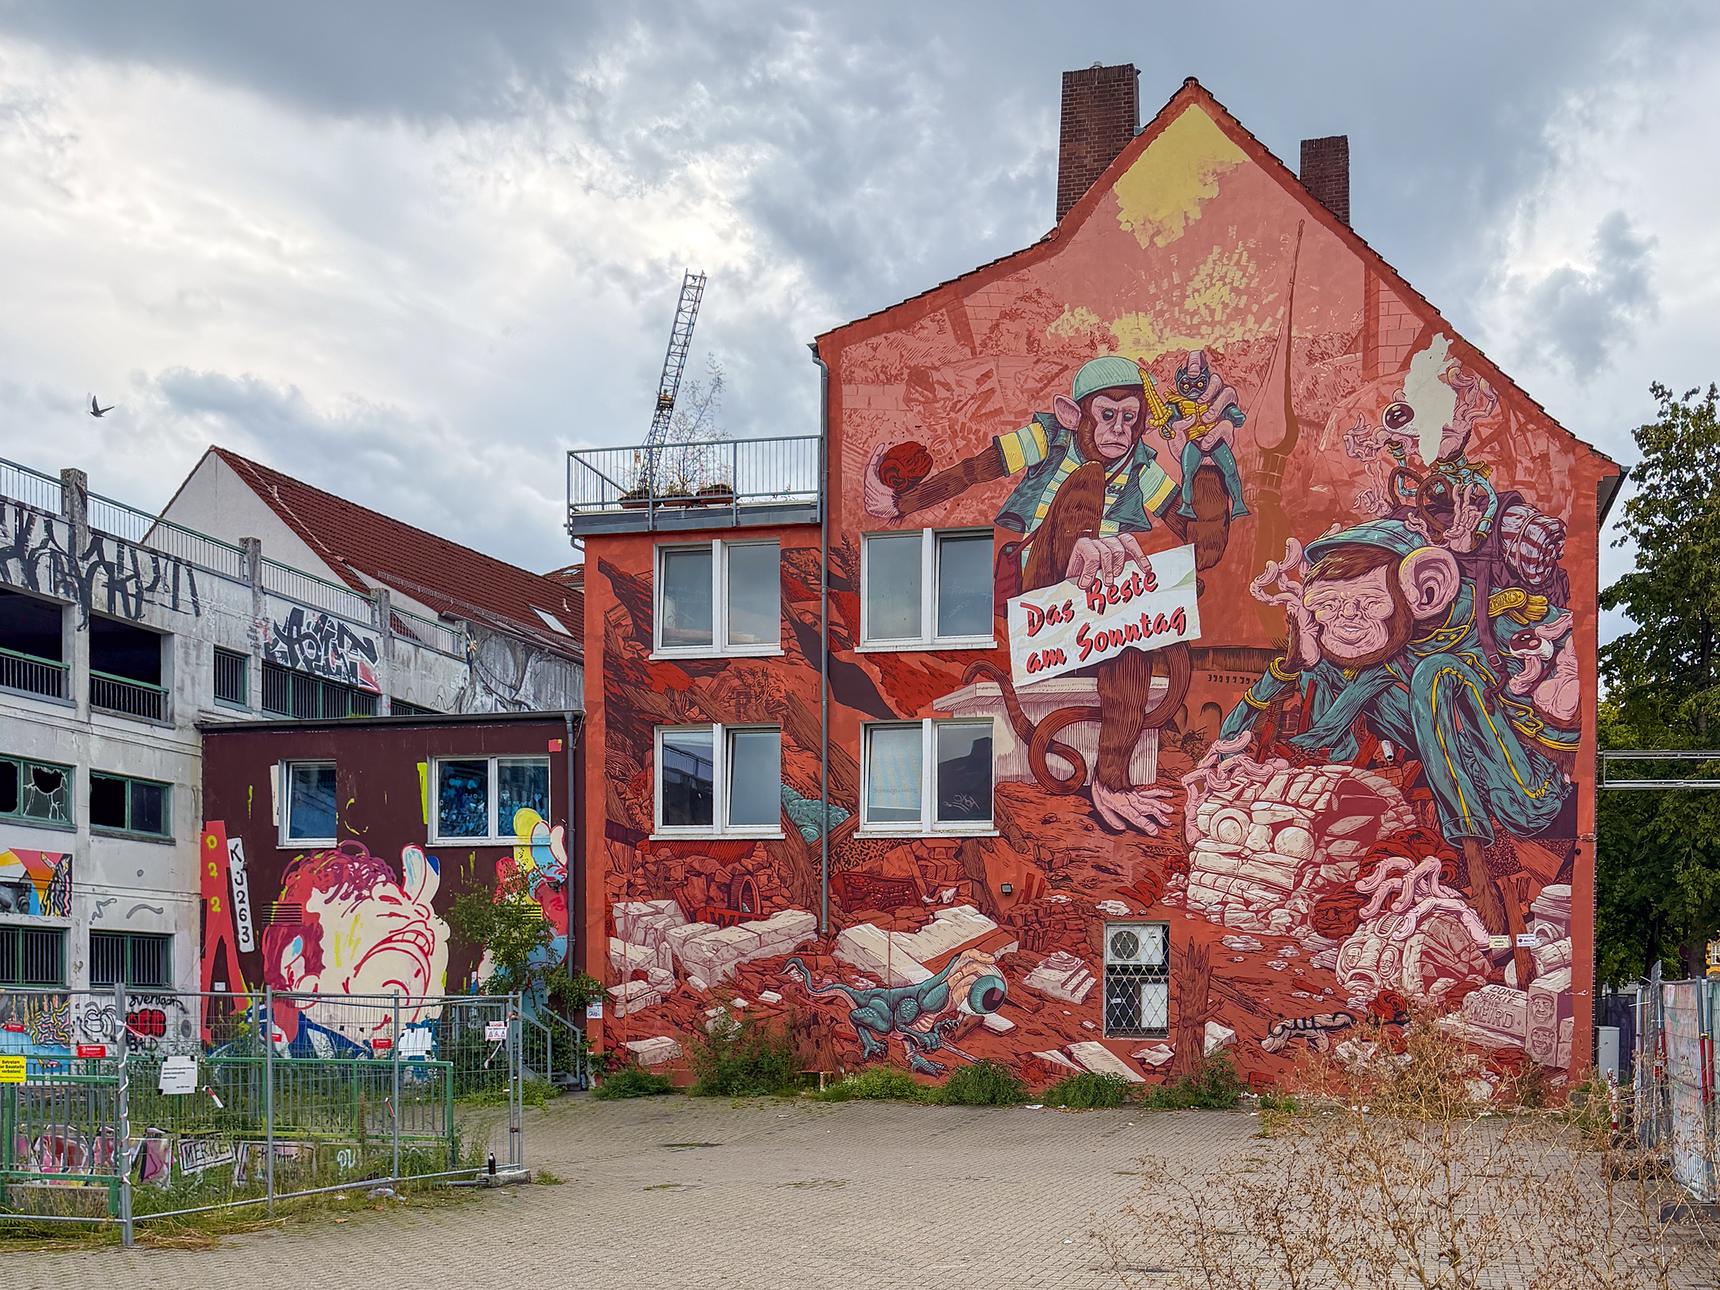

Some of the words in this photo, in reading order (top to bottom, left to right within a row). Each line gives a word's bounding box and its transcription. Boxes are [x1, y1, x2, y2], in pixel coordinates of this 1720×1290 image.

[1019, 598, 1075, 638] Das
[1025, 647, 1068, 675] am
[1075, 606, 1188, 663] Sonntag
